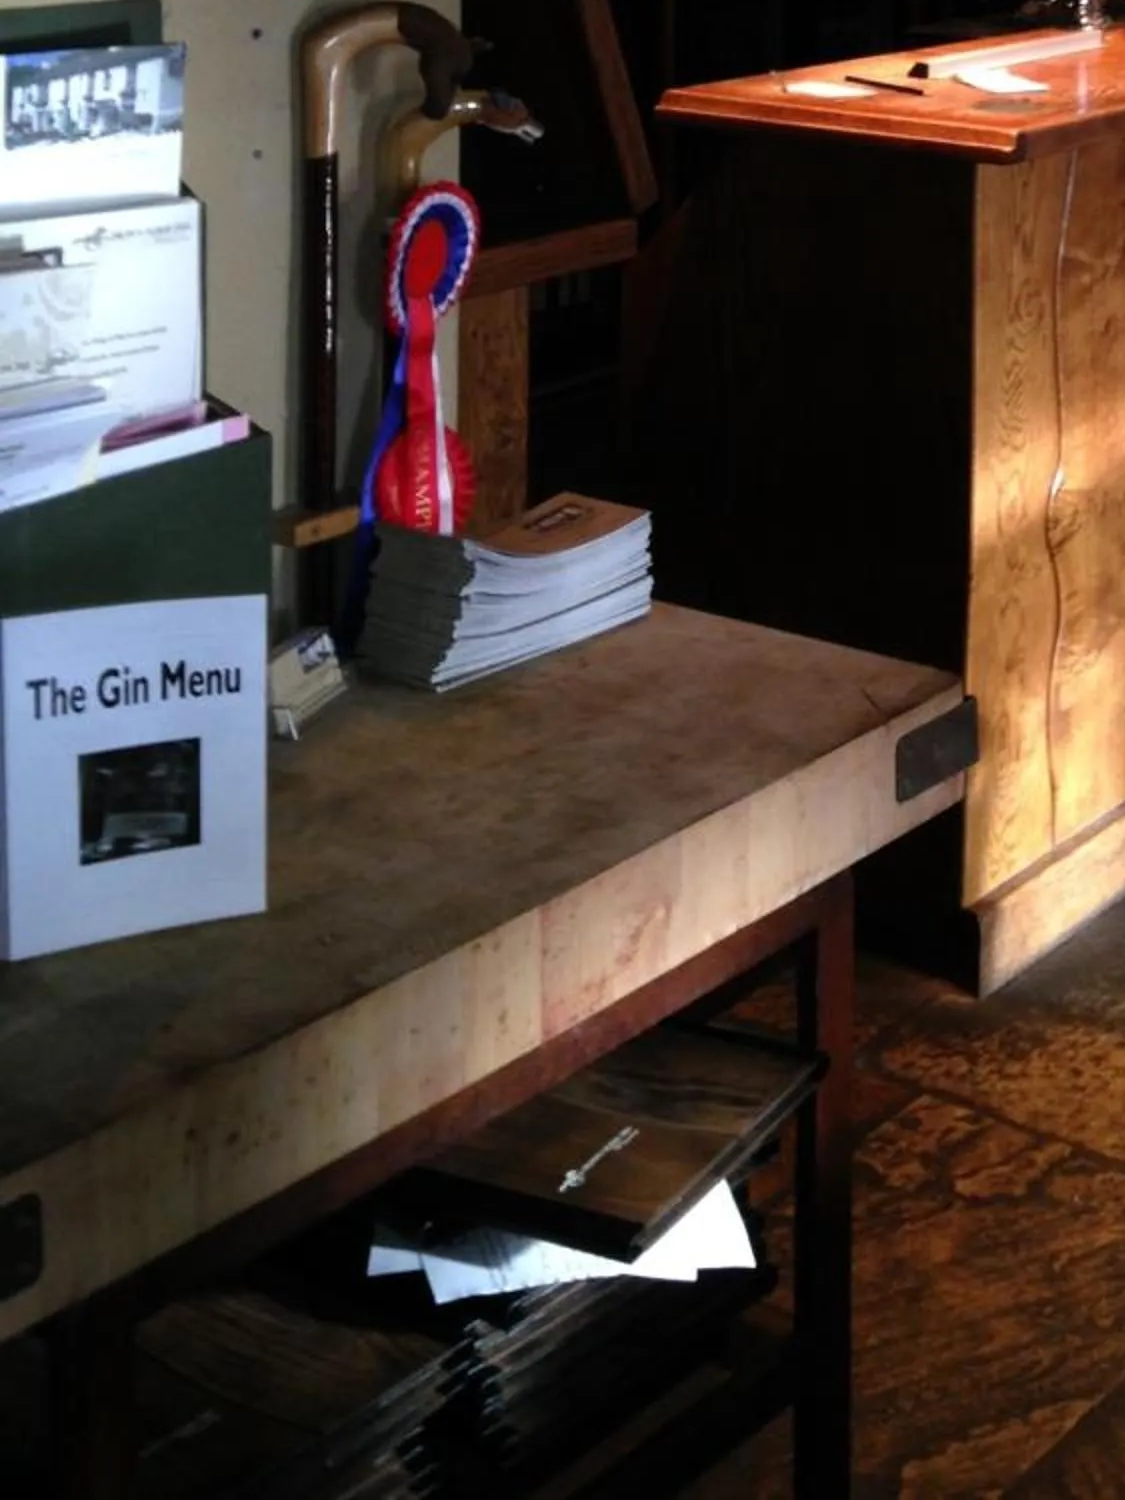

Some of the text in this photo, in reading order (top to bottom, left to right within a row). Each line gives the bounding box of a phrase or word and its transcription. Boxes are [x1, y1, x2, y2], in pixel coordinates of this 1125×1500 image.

[26, 660, 242, 720] The Gin Menu
